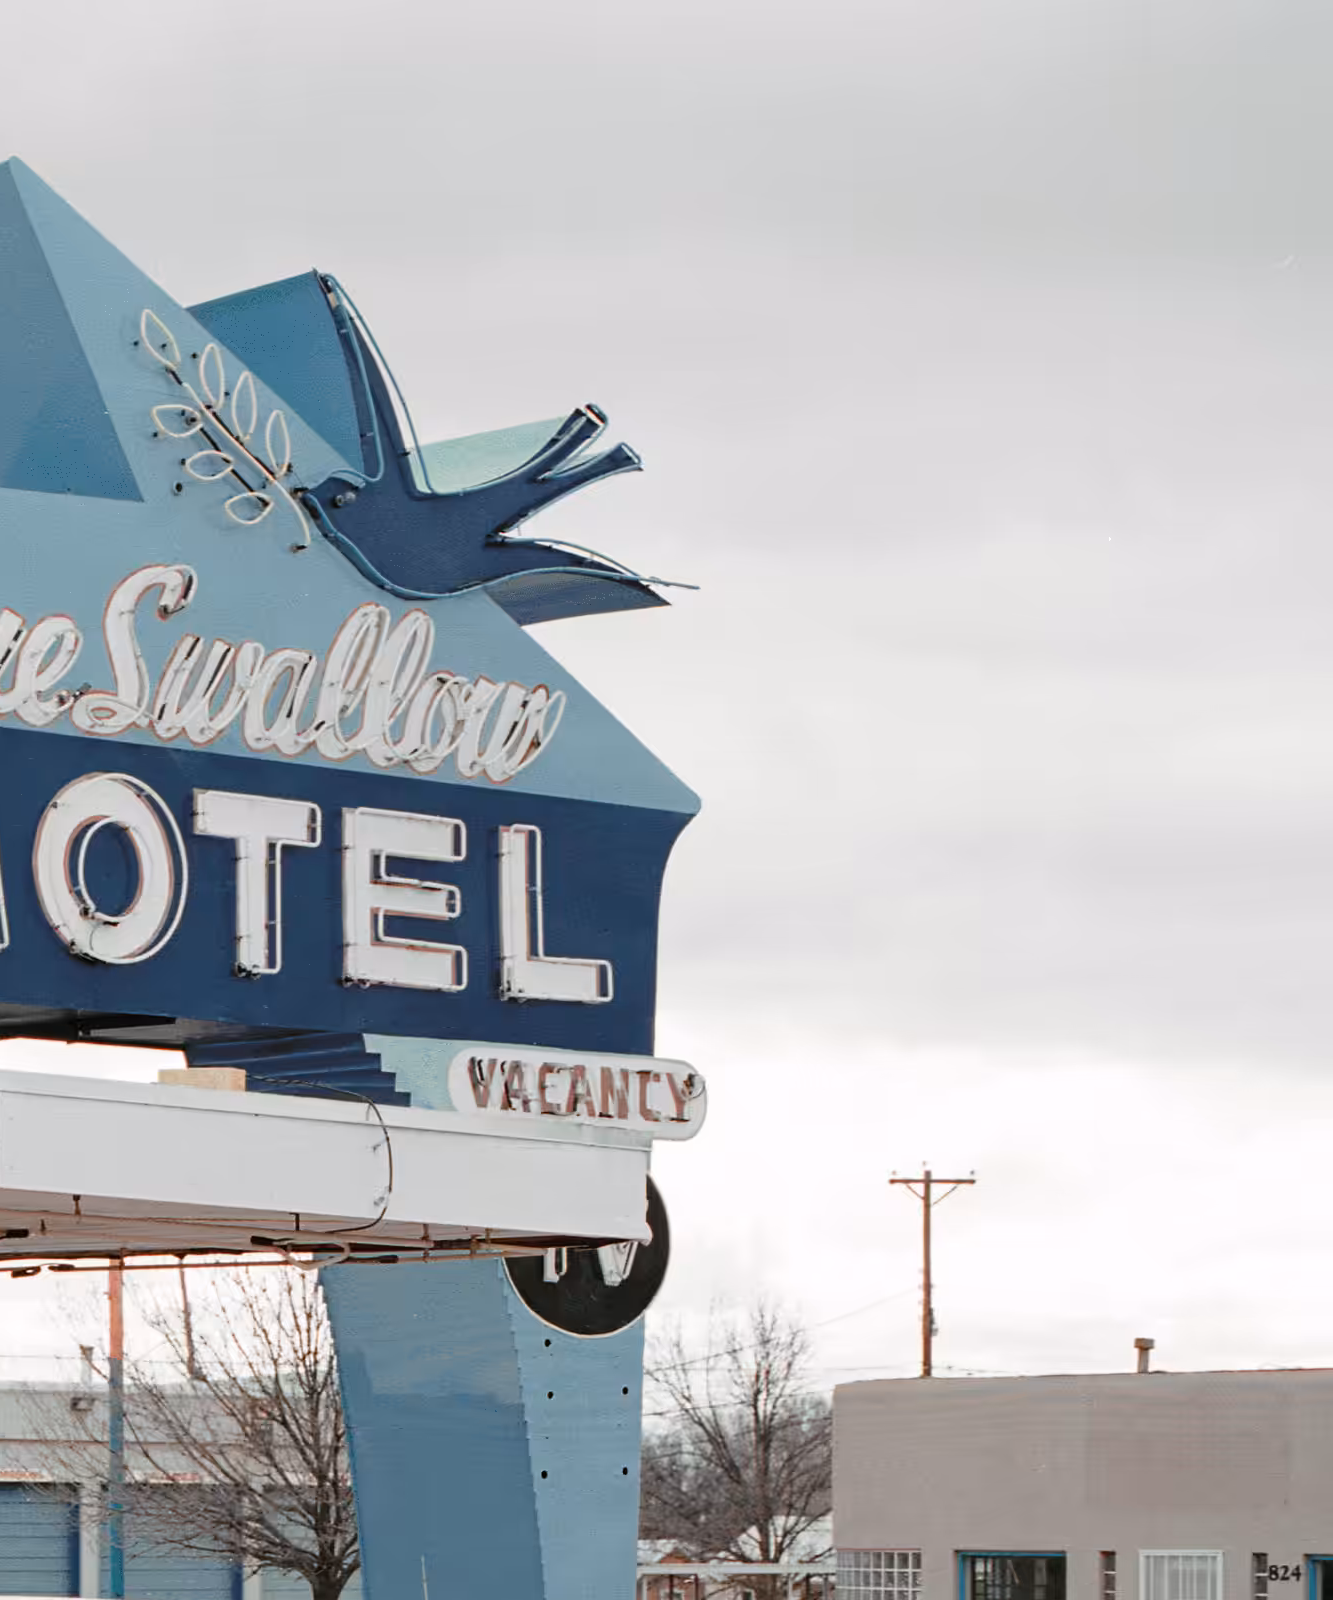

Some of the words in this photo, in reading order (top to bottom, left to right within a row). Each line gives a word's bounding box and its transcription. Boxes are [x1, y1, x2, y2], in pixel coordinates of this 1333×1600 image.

[71, 563, 566, 783] Swallow
[467, 1055, 695, 1123] VACANCY
[1267, 1564, 1302, 1582] 824
